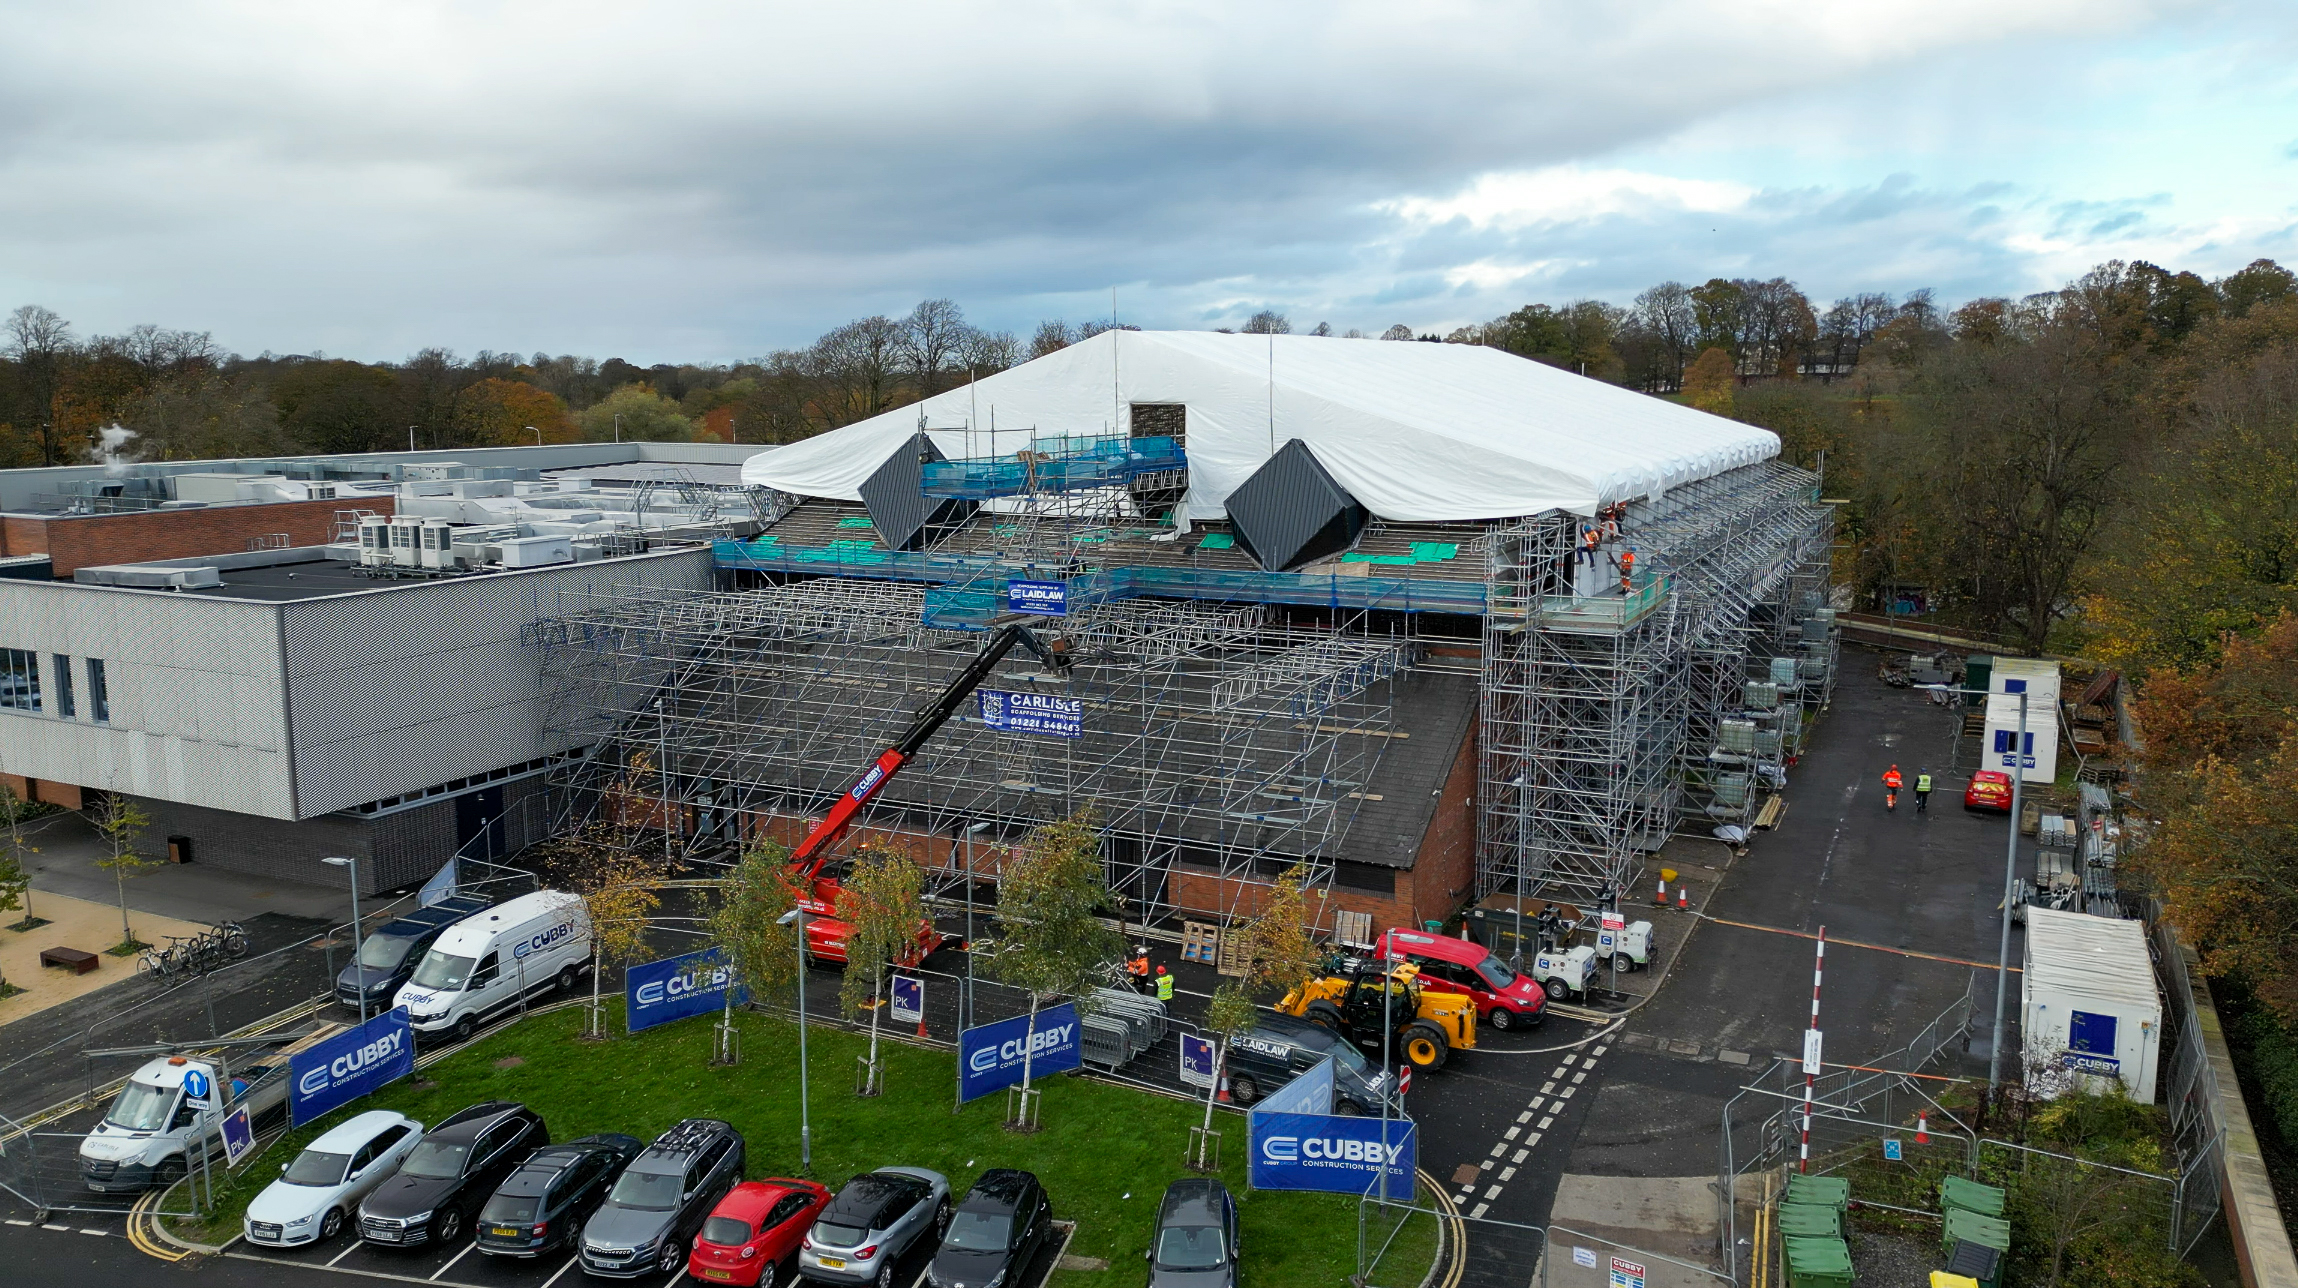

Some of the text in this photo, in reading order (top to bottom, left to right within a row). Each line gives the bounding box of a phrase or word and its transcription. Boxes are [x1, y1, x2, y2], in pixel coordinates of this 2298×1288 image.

[1022, 590, 1064, 600] LAIDLAW
[1010, 694, 1080, 712] CARLISLE
[1010, 709, 1080, 721] SCAFFOLDING SERVICES
[859, 764, 881, 789] CUBBY
[531, 919, 574, 949] CUBBY
[667, 965, 733, 995] CUBY
[402, 992, 435, 1005] CUBBY
[895, 996, 908, 1008] PK
[1000, 1022, 1074, 1060] CUBBY
[1242, 1037, 1290, 1058] LAIDLAW
[331, 1028, 403, 1078] CUBBY
[1000, 1042, 1073, 1069] CONSTRTION SERVICES
[332, 1048, 405, 1088] CONSTRUCTION SERVICES
[1184, 1056, 1198, 1071] PK
[2076, 1058, 2119, 1072] CUBBY
[230, 1136, 245, 1155] PK
[1302, 1138, 1404, 1165] CUBBY
[1302, 1160, 1404, 1175] CONSTRUCTION SERCES
[1613, 1259, 1642, 1273] CUBBY
